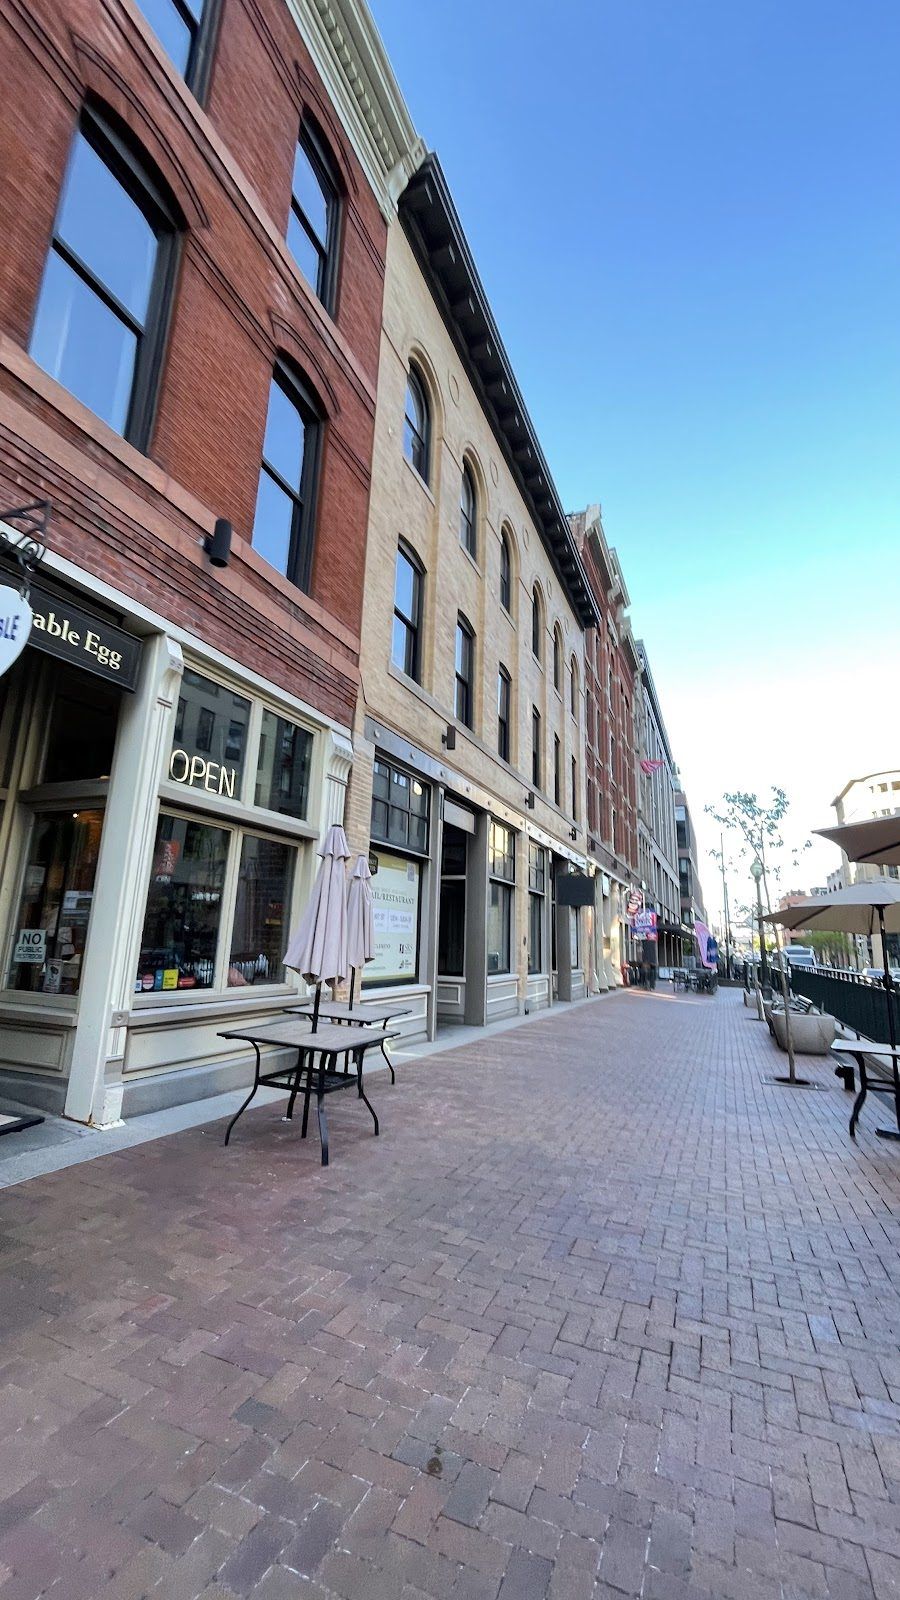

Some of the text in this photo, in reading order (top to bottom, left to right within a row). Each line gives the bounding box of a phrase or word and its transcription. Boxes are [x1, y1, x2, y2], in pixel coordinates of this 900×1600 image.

[31, 612, 122, 670] able Egg
[170, 749, 235, 798] OPEN
[22, 933, 42, 945] NO
